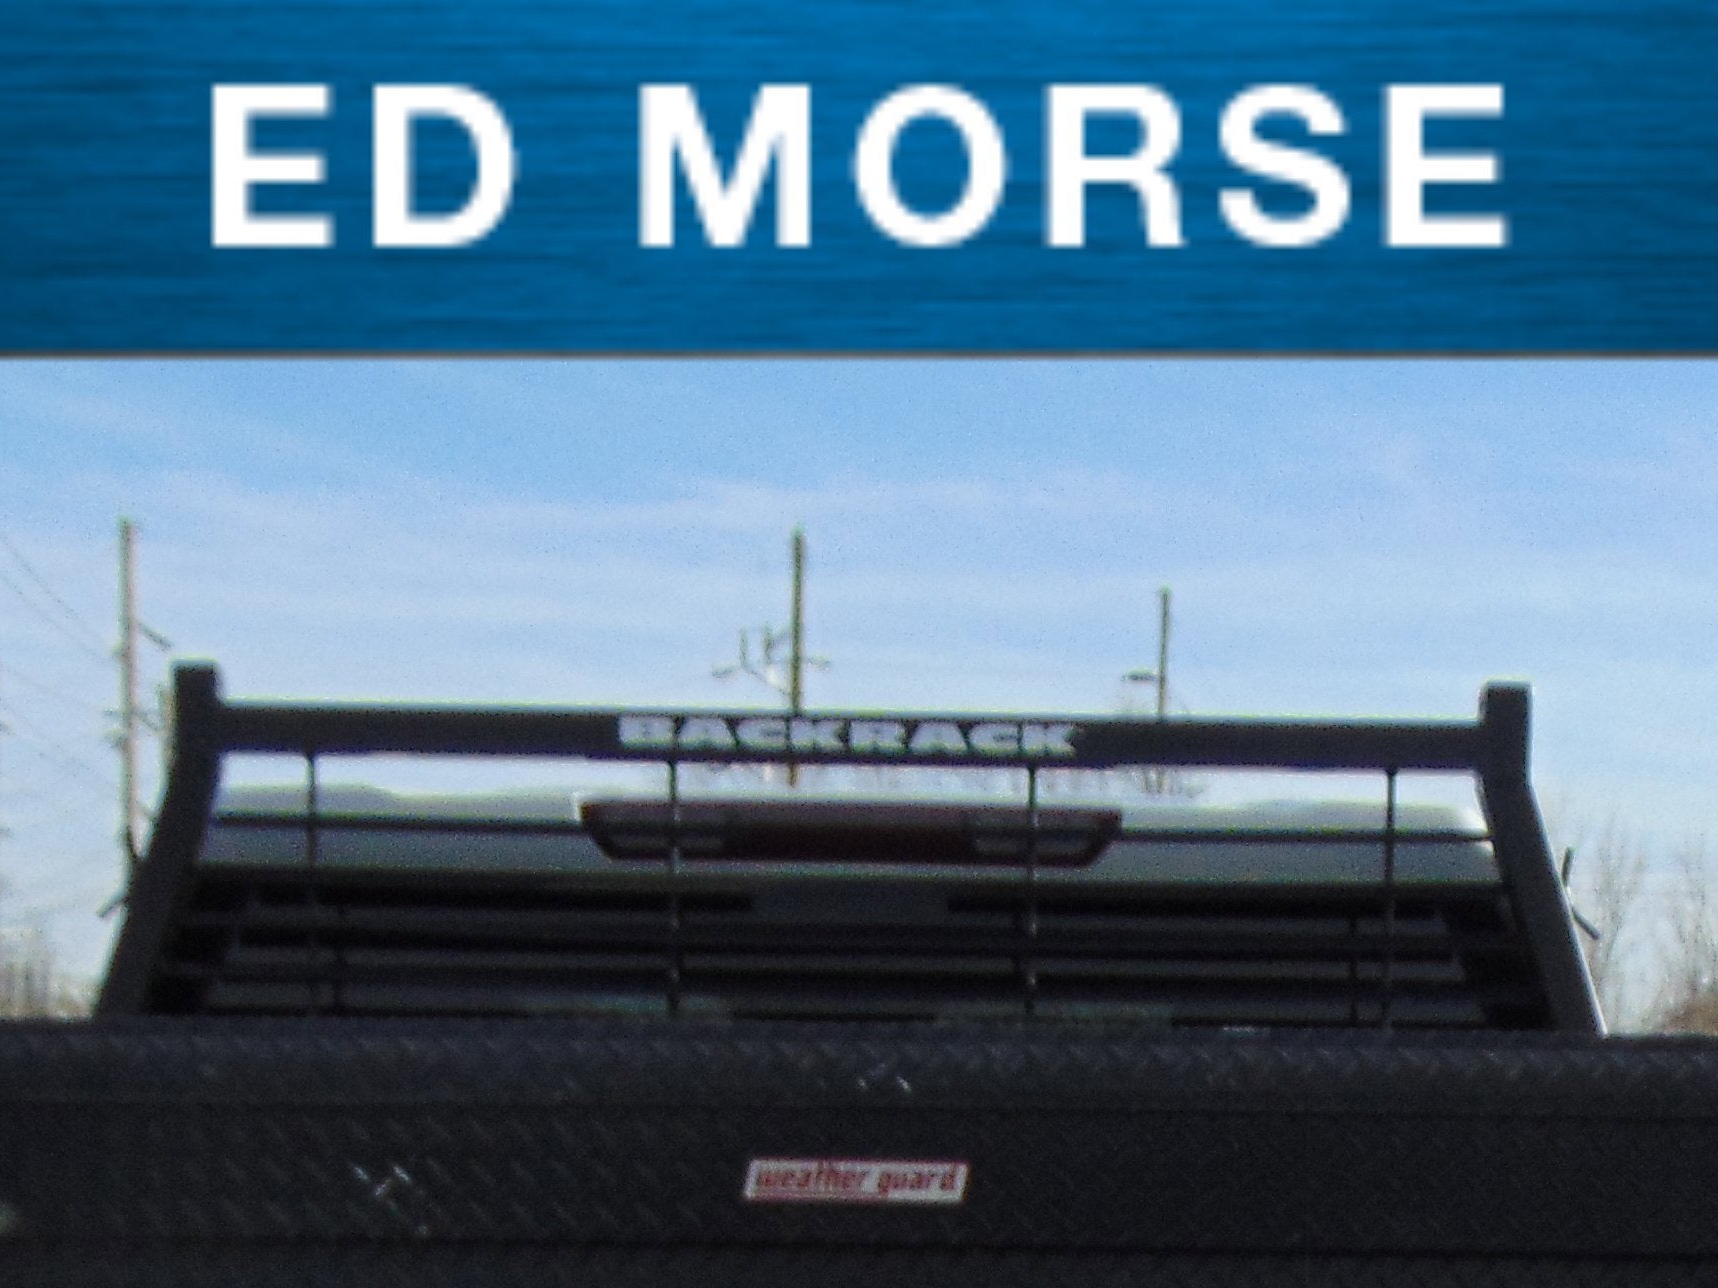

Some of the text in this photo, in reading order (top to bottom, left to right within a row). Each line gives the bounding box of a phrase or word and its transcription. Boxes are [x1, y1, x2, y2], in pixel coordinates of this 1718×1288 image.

[617, 713, 1077, 757] BACKRACK
[755, 1161, 958, 1197] weather guard
